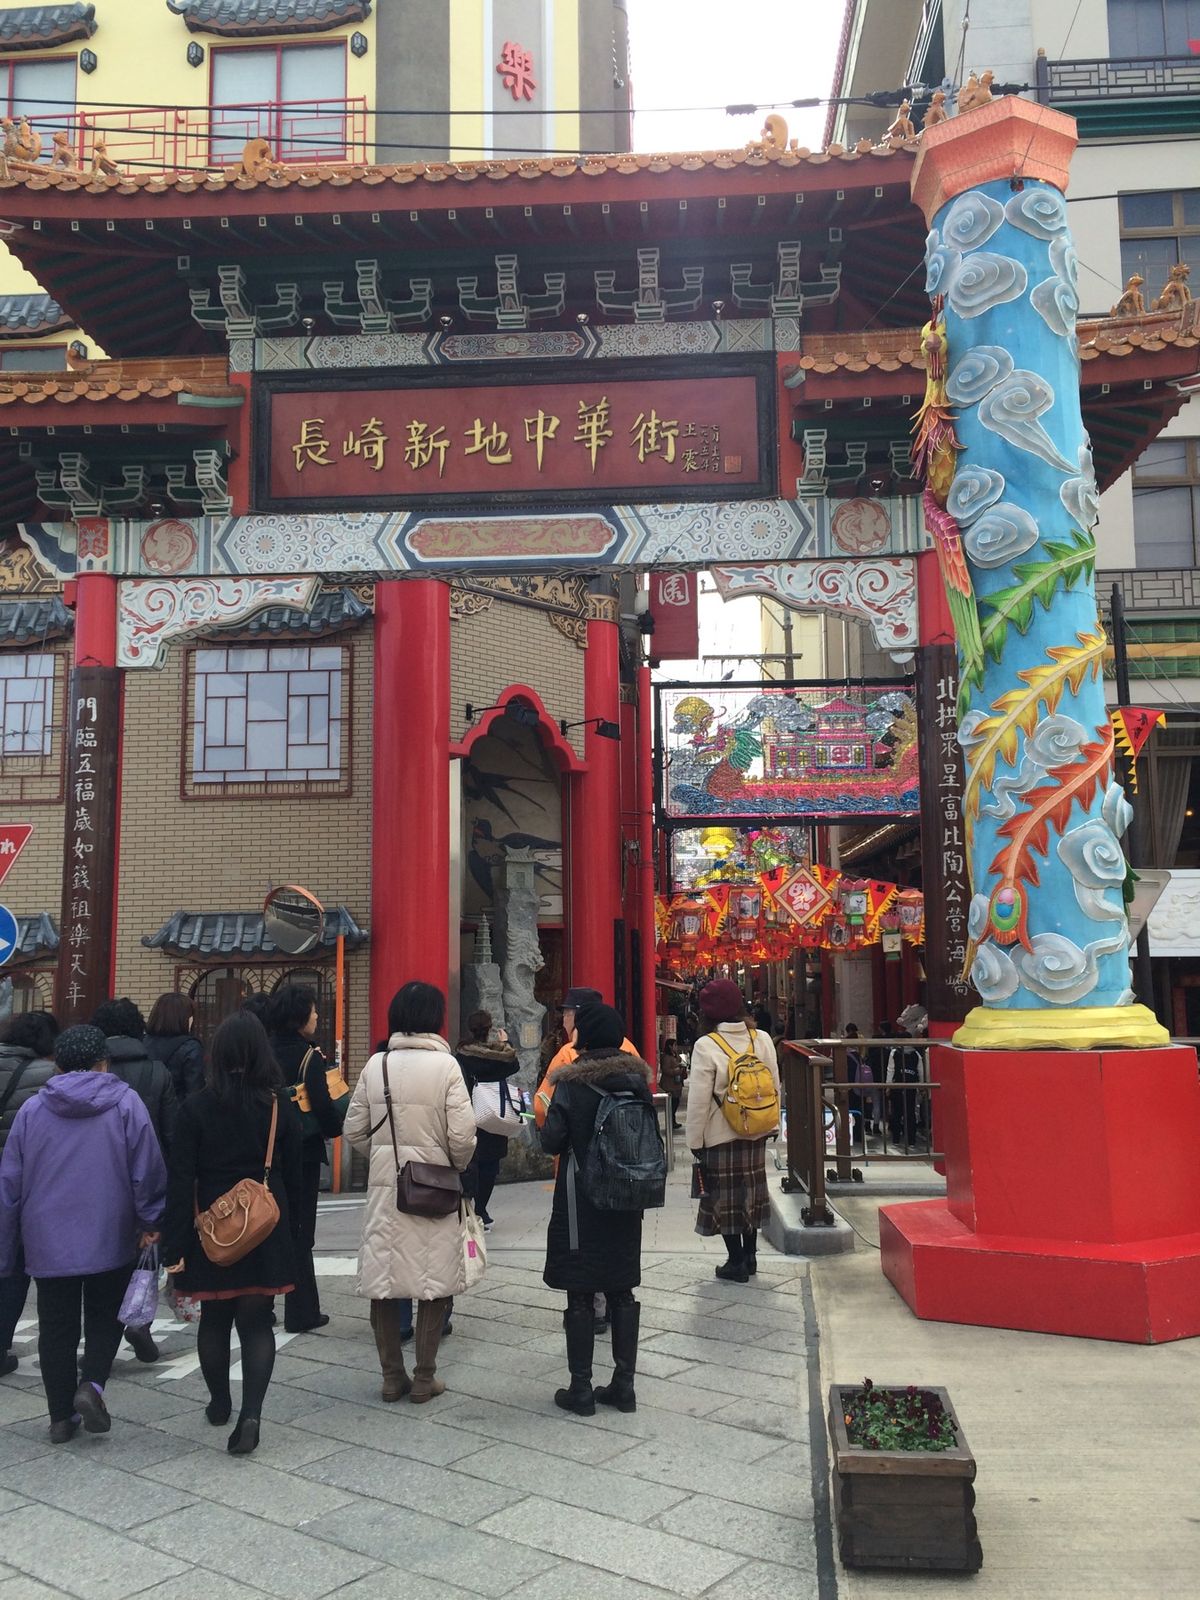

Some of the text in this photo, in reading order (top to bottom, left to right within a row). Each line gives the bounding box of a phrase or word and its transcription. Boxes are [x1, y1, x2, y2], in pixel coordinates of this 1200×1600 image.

[496, 41, 536, 101] 樂
[292, 396, 679, 478] 長崎新地中華街
